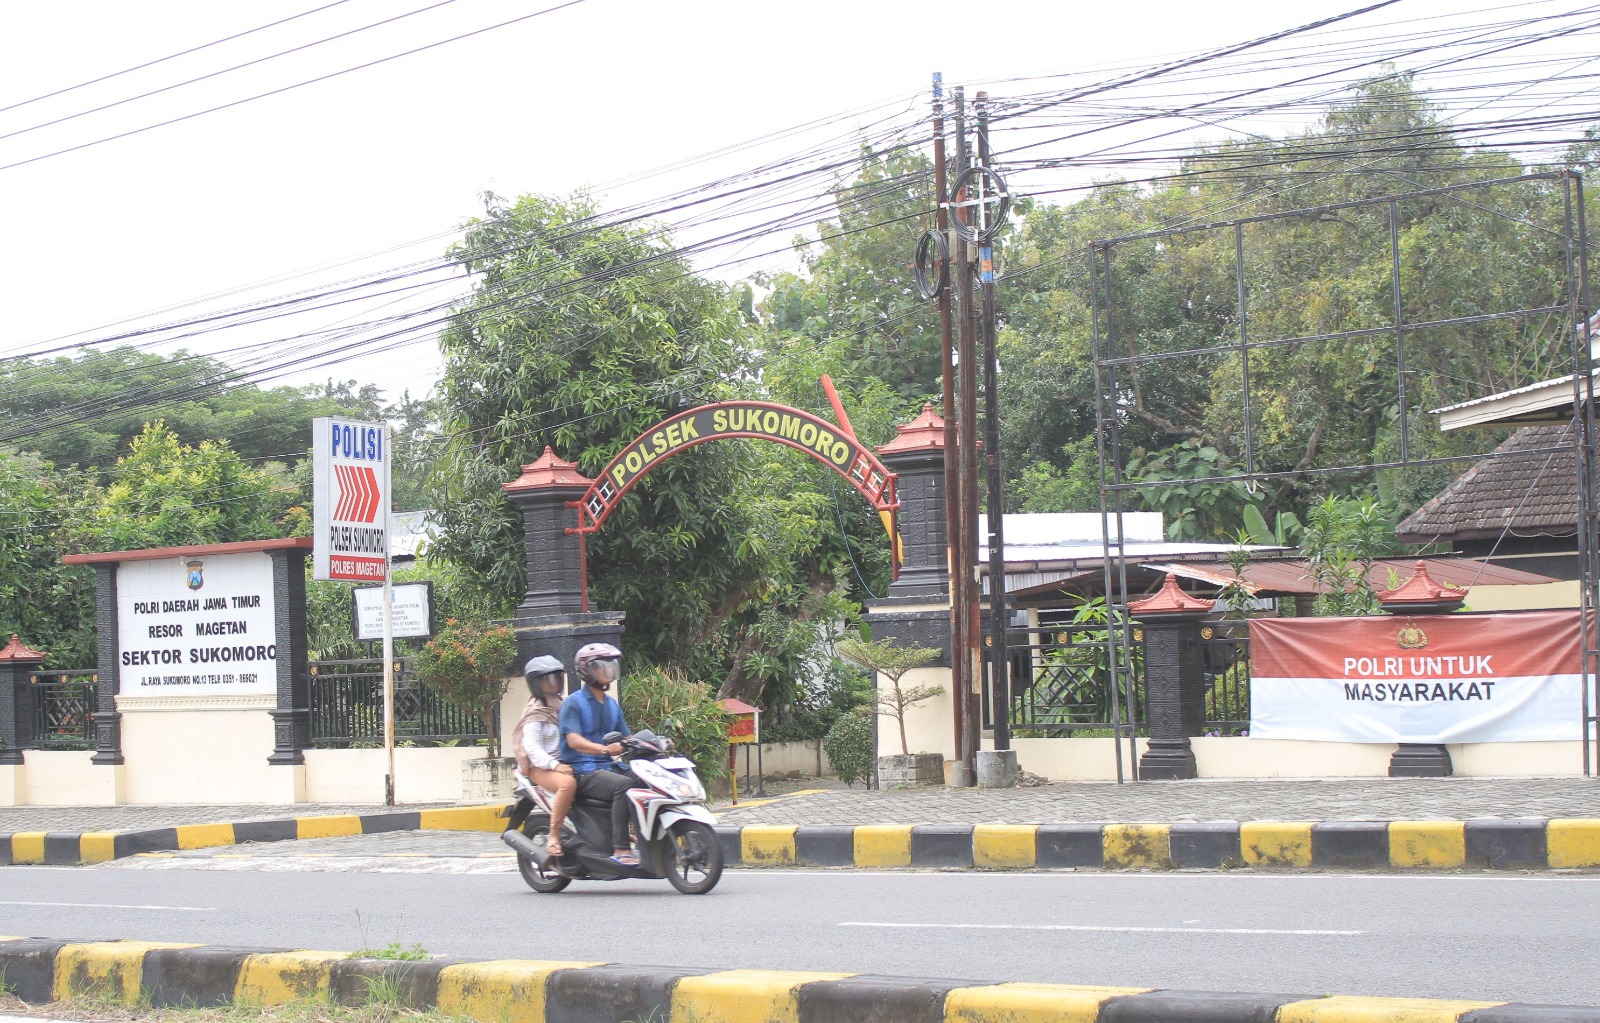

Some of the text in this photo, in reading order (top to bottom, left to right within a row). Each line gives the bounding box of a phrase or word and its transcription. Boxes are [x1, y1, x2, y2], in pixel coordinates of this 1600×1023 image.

[332, 422, 383, 463] POLISI
[612, 408, 849, 488] POLSEK SUKOMORO
[330, 525, 384, 554] POLSEK SUKOMORO
[331, 559, 385, 577] POLRES MAGETAN
[134, 595, 261, 615] POLRI DAERAH JAWA TIMUR
[148, 620, 247, 639] RESOR MAGETAN
[122, 644, 277, 666] SEKTOR SUKOMORO
[1344, 655, 1493, 676] POLRI UNTUK
[162, 674, 191, 686] SUKOMORO
[222, 673, 235, 684] 0351
[1344, 681, 1495, 702] MASYARAKAT
